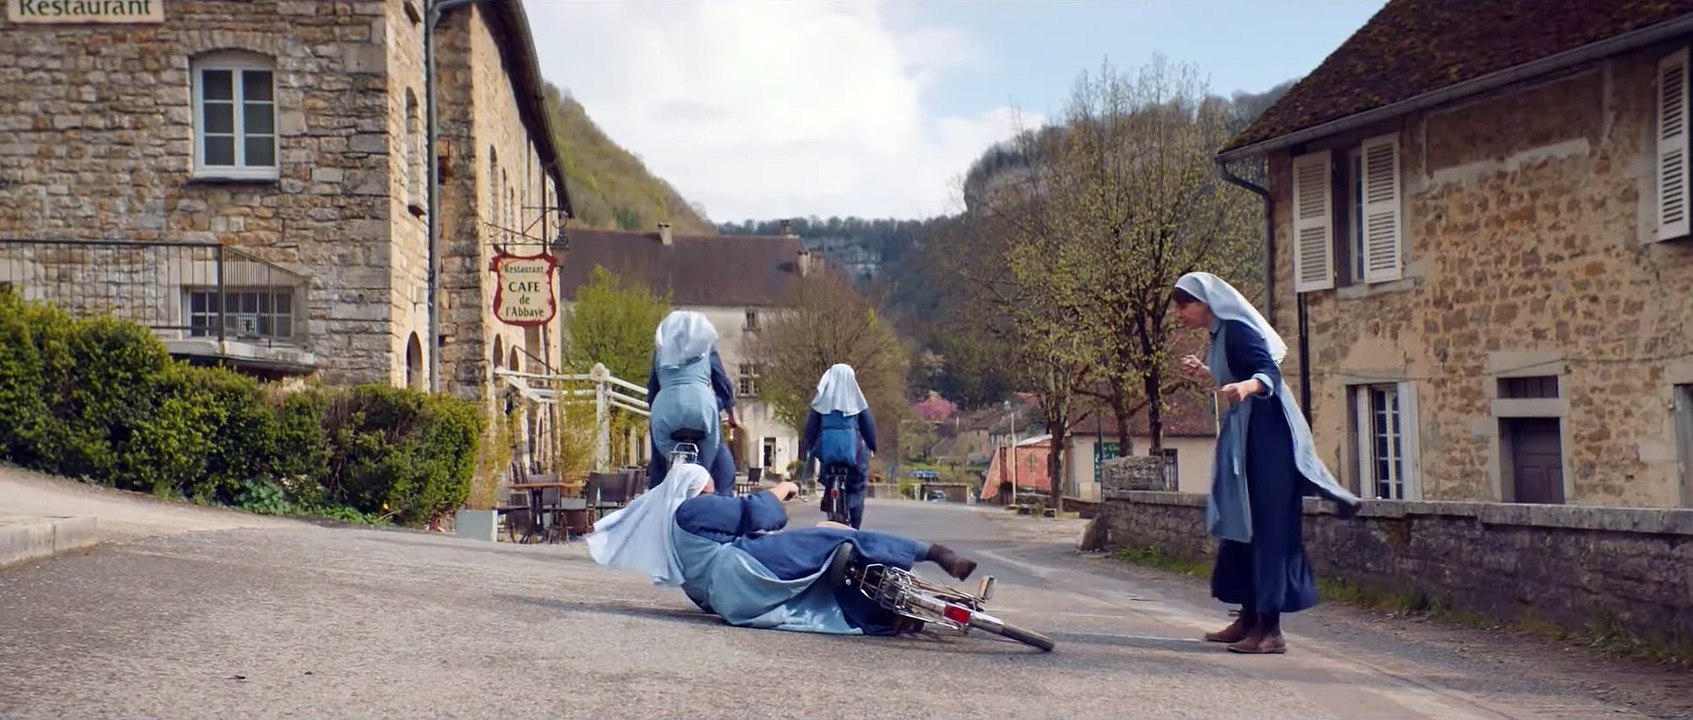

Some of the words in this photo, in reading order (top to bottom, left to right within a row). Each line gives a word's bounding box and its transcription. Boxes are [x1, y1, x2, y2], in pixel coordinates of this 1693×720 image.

[20, 0, 151, 15] Restaurant
[504, 264, 544, 273] Restaurant
[508, 281, 540, 292] CAFE
[519, 294, 530, 305] de
[505, 306, 544, 318] l'Abbaye
